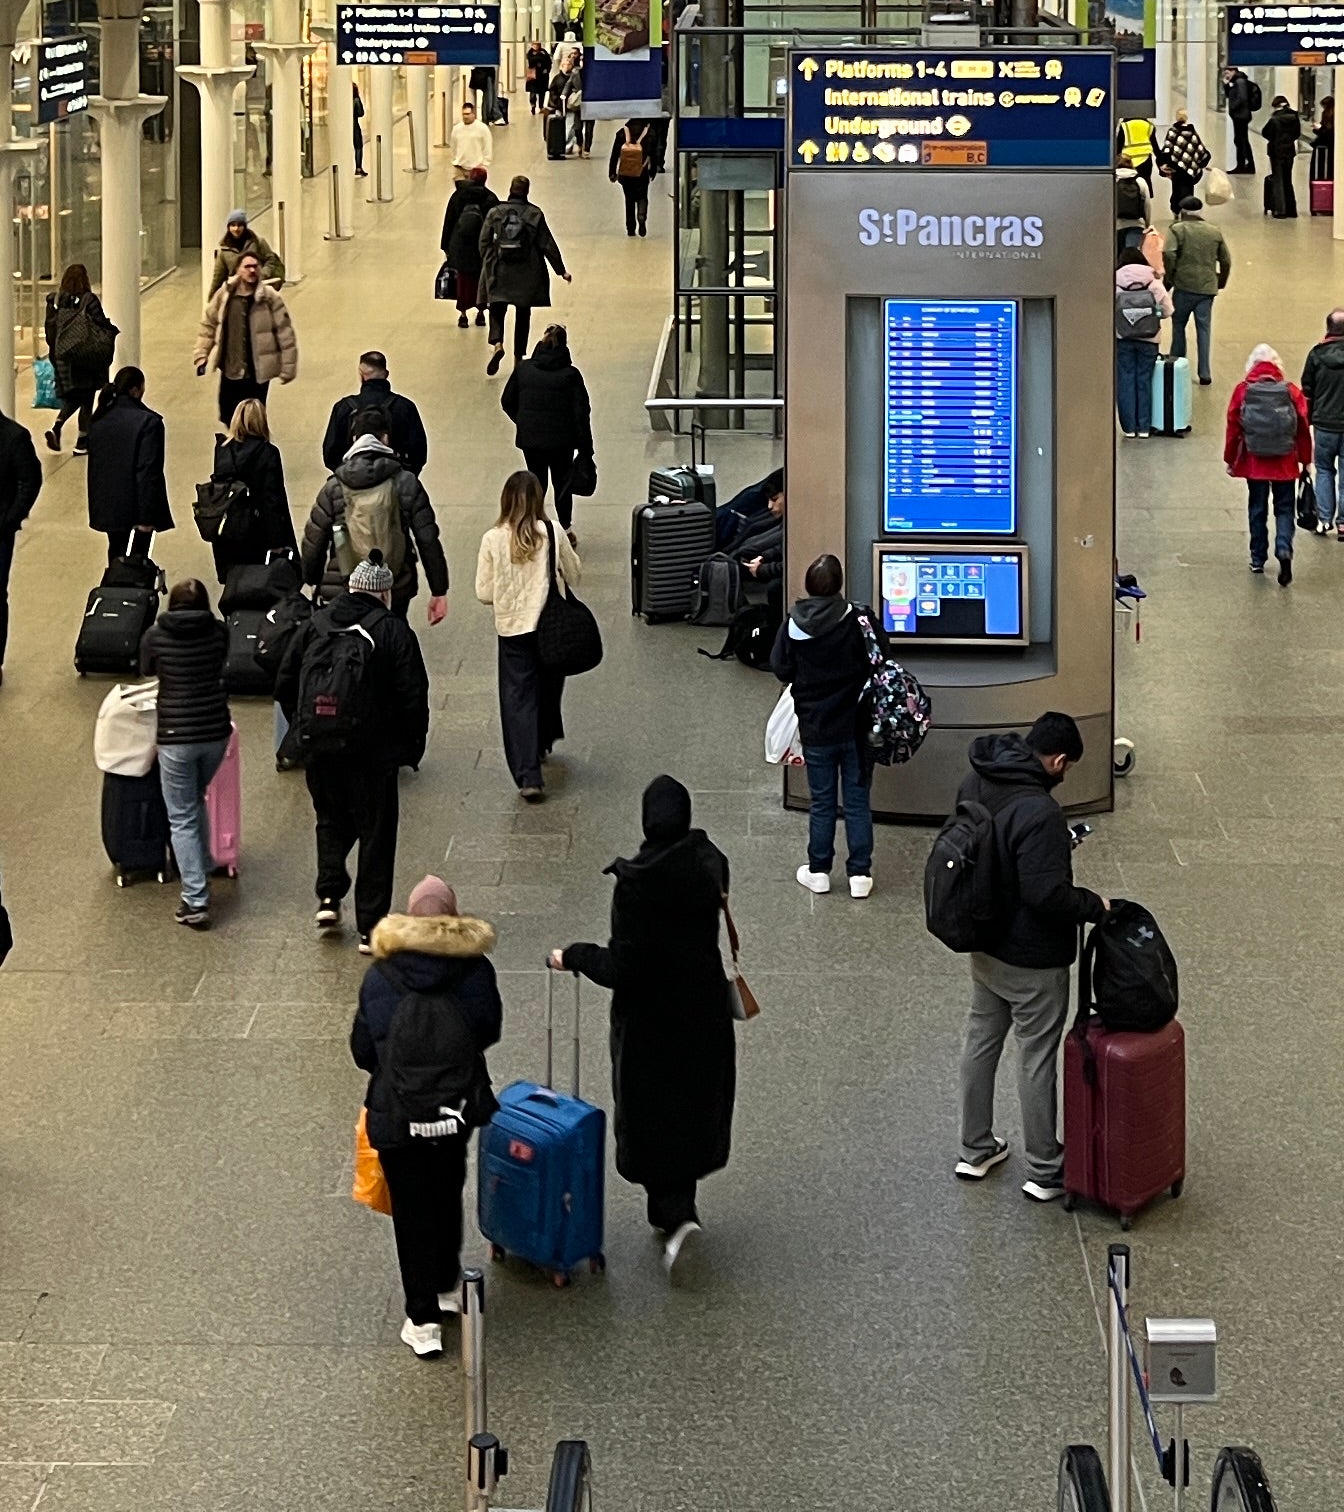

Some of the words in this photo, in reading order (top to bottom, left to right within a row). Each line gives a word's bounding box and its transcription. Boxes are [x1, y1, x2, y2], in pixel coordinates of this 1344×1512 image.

[825, 60, 914, 79] Platforms
[916, 61, 947, 78] 1-4
[825, 88, 940, 106] International
[942, 88, 995, 106] trains
[825, 115, 943, 139] Underground
[409, 1118, 458, 1137] PUMA
